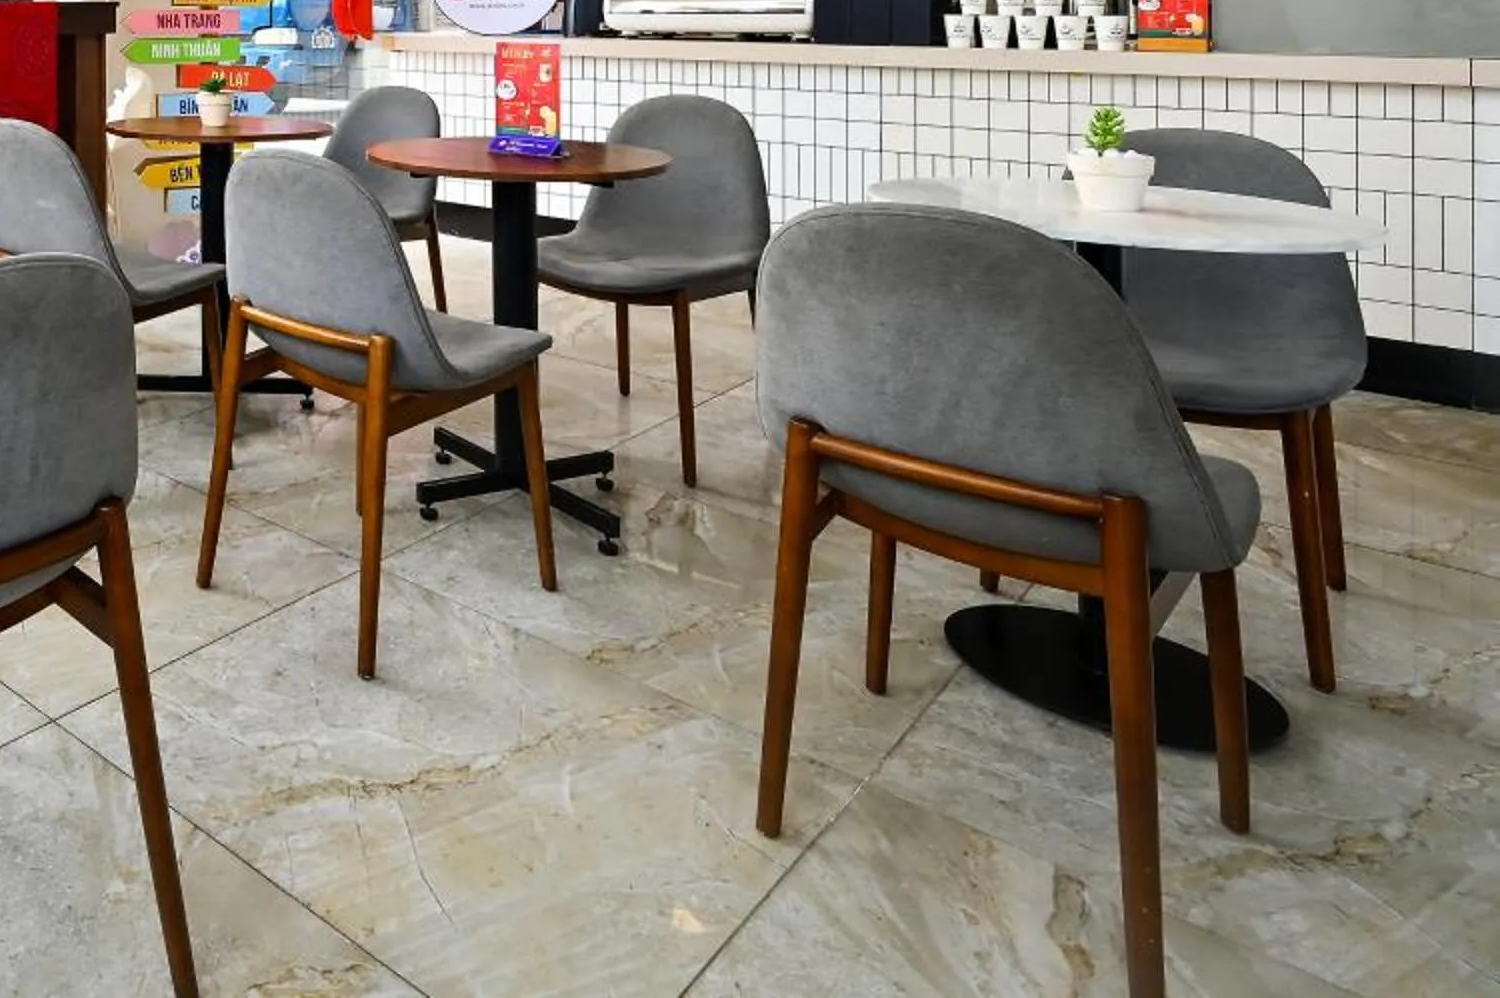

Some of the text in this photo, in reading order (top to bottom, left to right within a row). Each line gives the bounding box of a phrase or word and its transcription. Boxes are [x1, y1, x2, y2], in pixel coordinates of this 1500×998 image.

[157, 13, 221, 29] NHA TRANG
[151, 43, 179, 59] NINH
